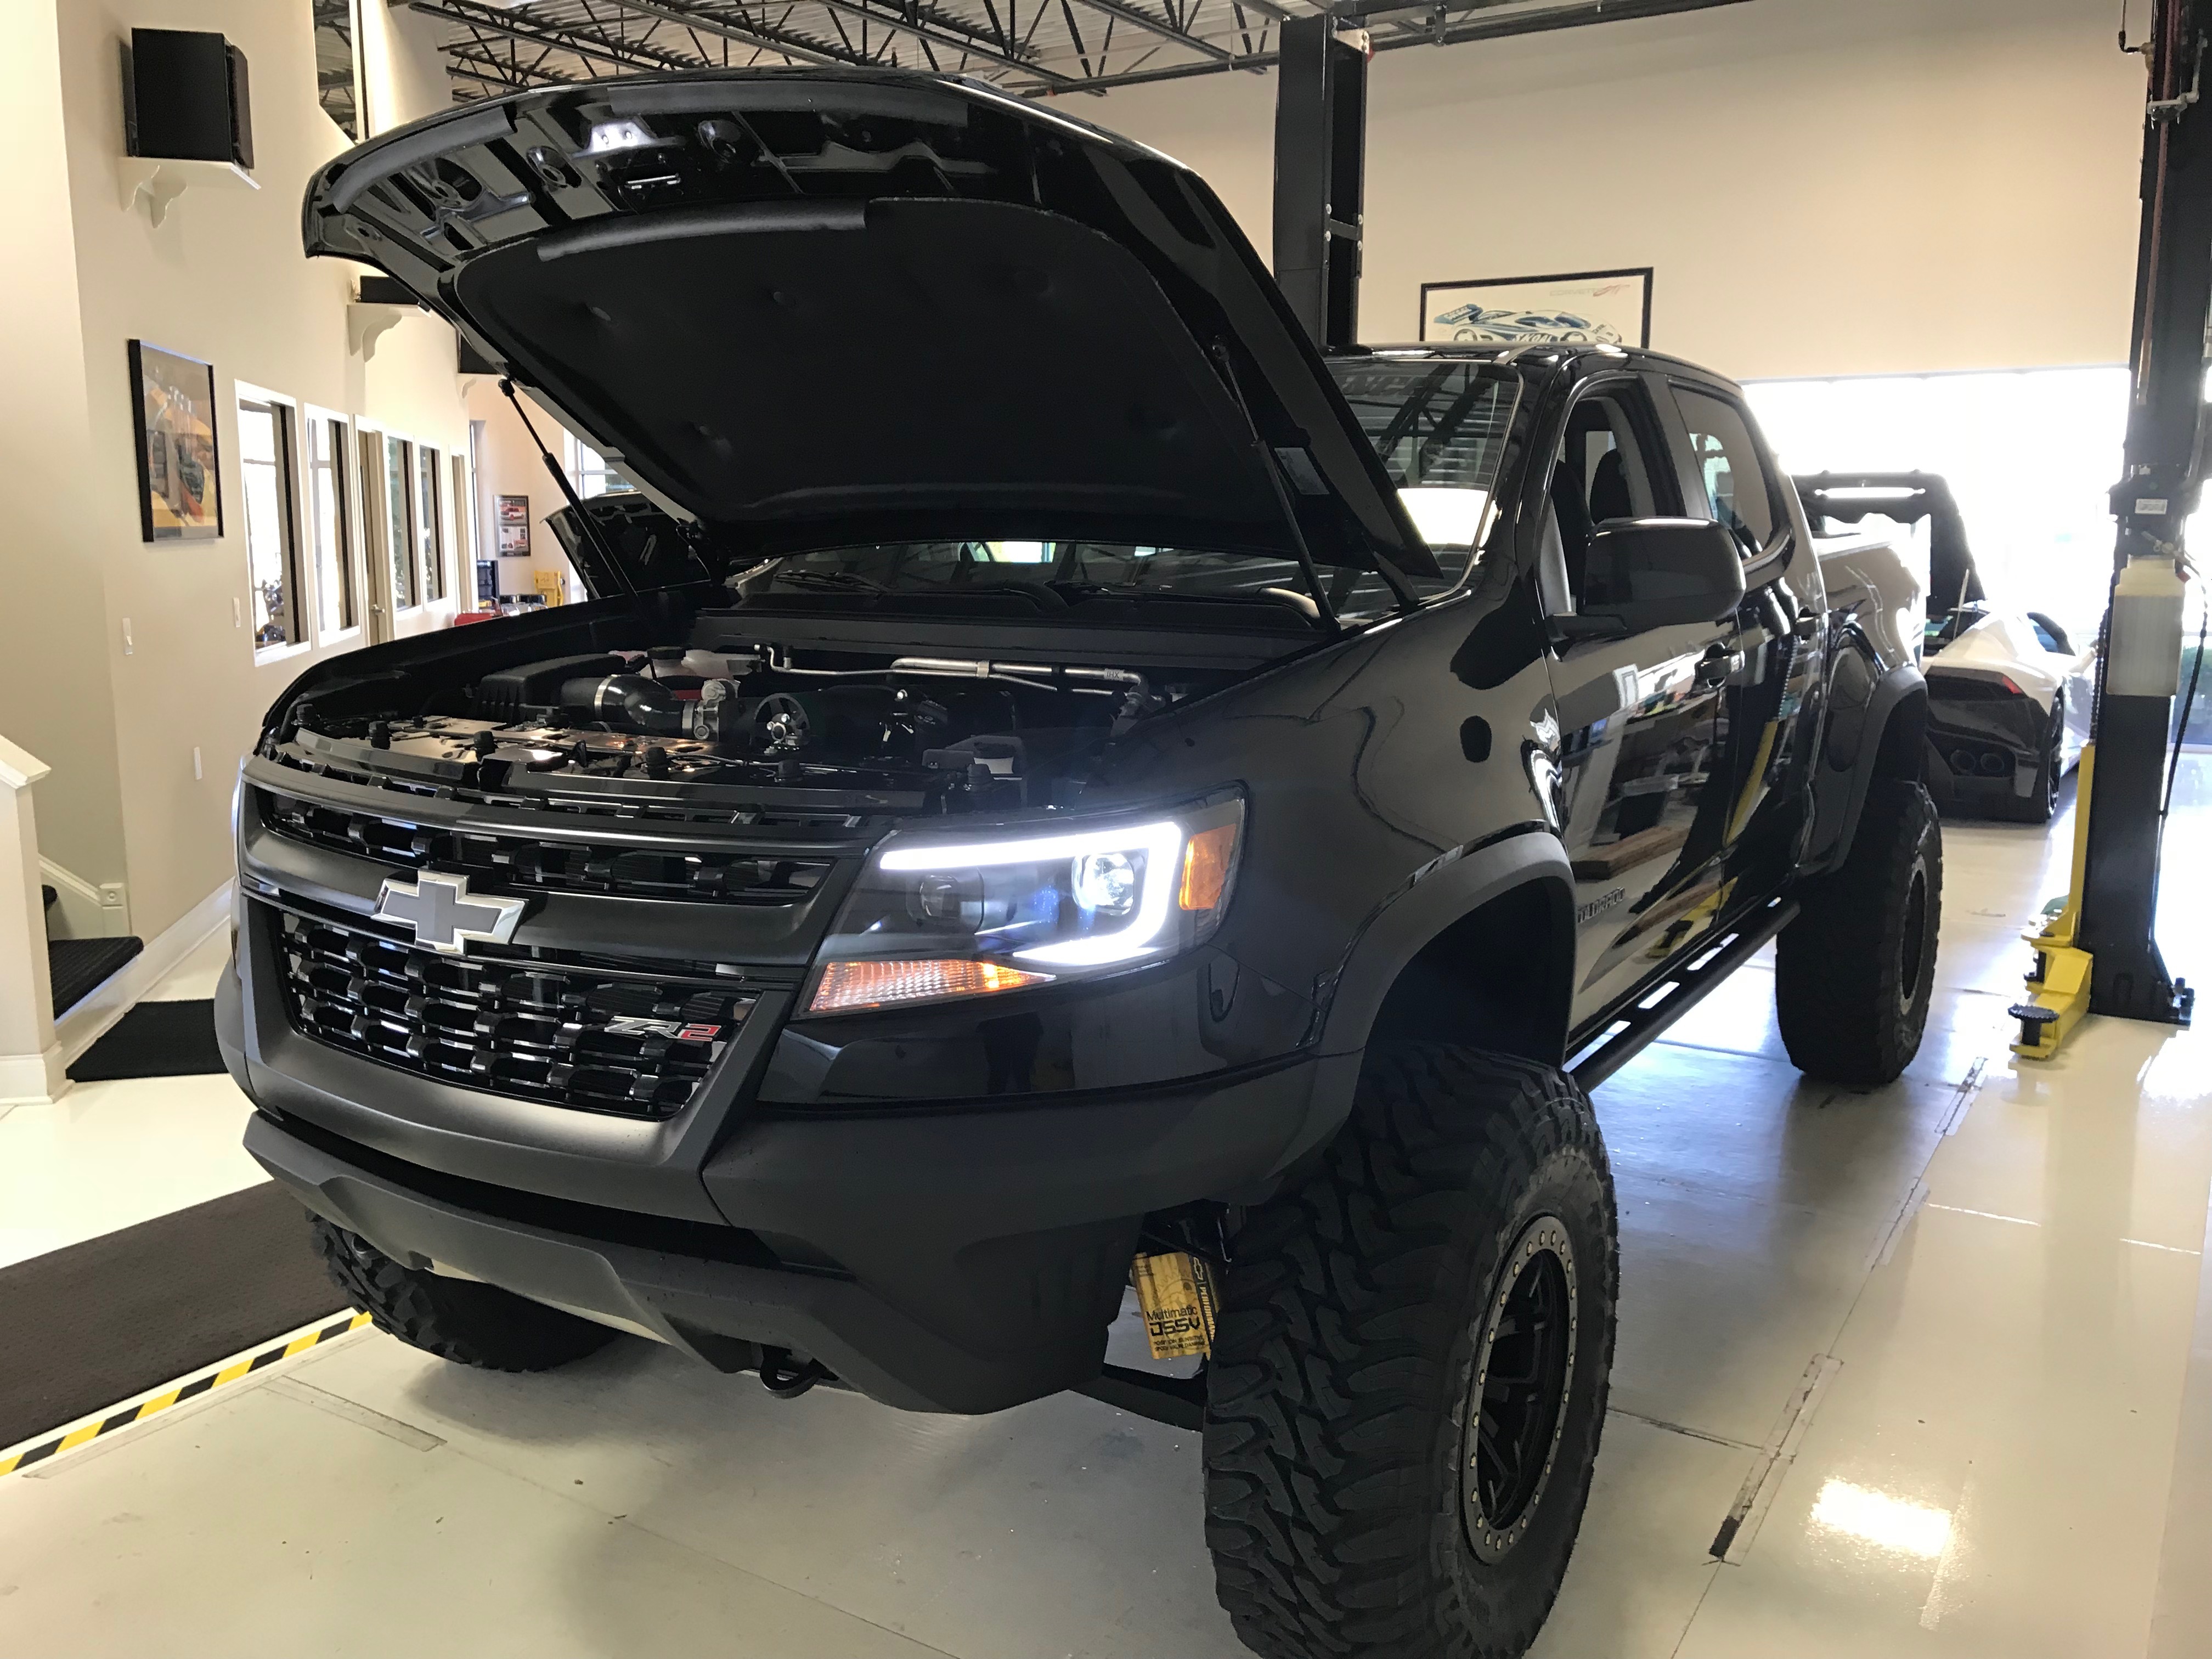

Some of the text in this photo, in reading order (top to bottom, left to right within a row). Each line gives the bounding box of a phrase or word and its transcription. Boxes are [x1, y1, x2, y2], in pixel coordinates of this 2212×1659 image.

[603, 1015, 722, 1042] ZR2
[1146, 1304, 1198, 1321] Multimatic
[1149, 1316, 1200, 1336] DSSV
